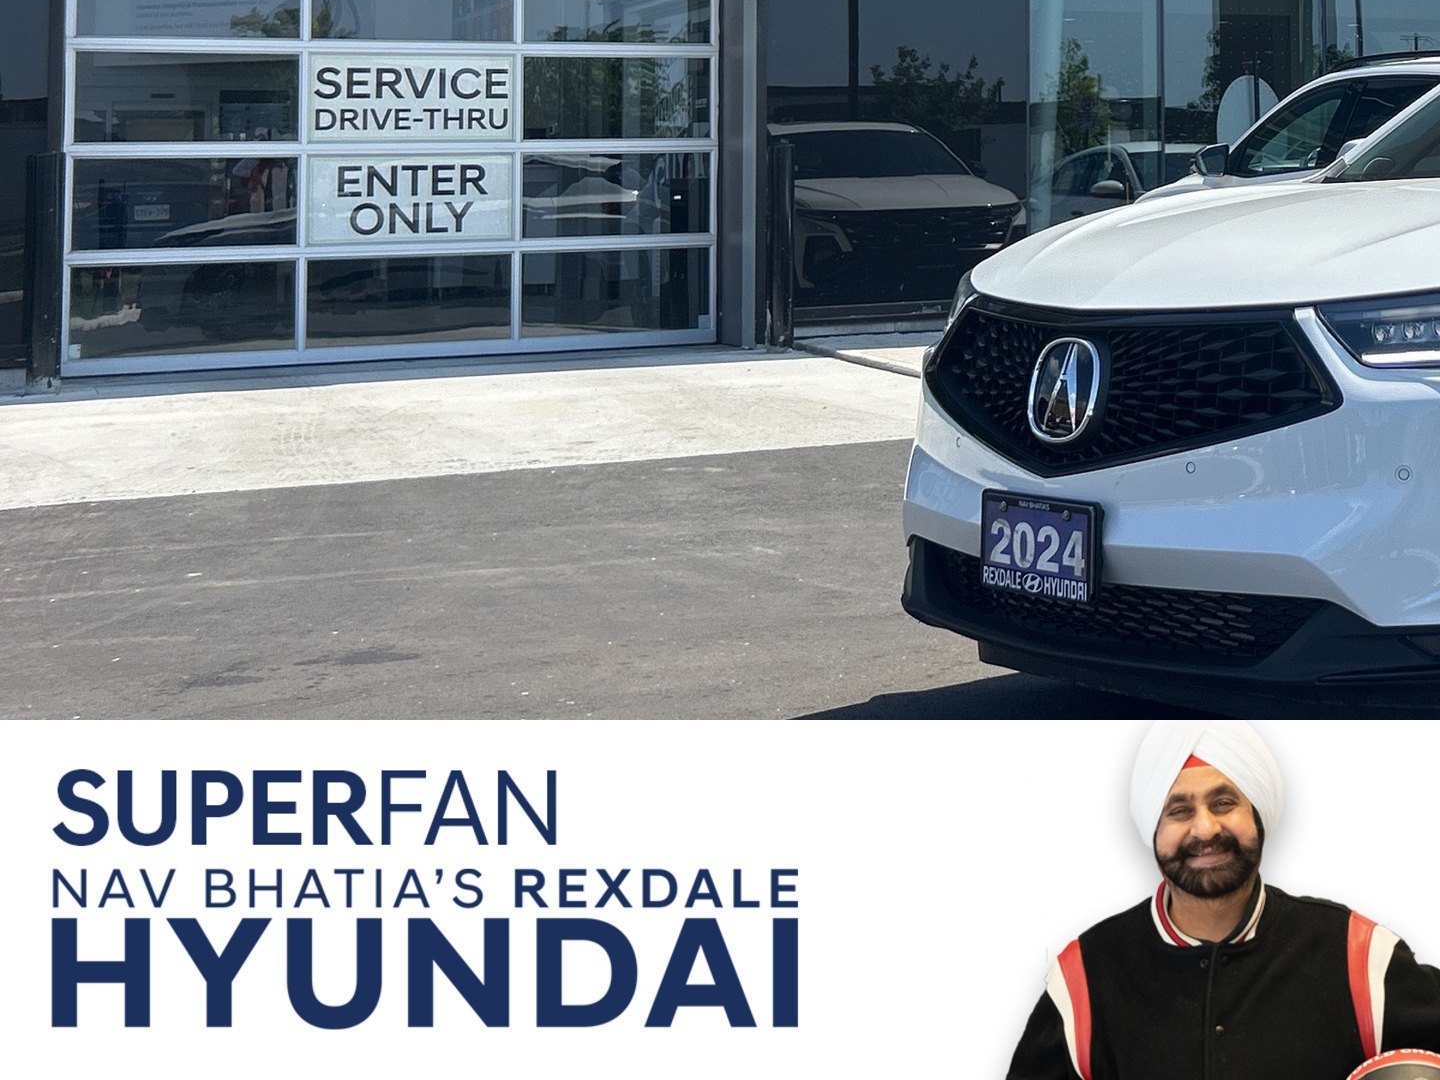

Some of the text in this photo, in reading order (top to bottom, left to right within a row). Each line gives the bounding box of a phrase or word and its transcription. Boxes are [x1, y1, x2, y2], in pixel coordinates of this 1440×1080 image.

[314, 67, 509, 99] SERVICE
[314, 108, 509, 131] DRIVE-THRU
[337, 164, 488, 197] ENTER
[350, 201, 474, 235] ONLY
[990, 518, 1085, 577] 2024
[983, 566, 1088, 602] REXDALE HYUNDAI
